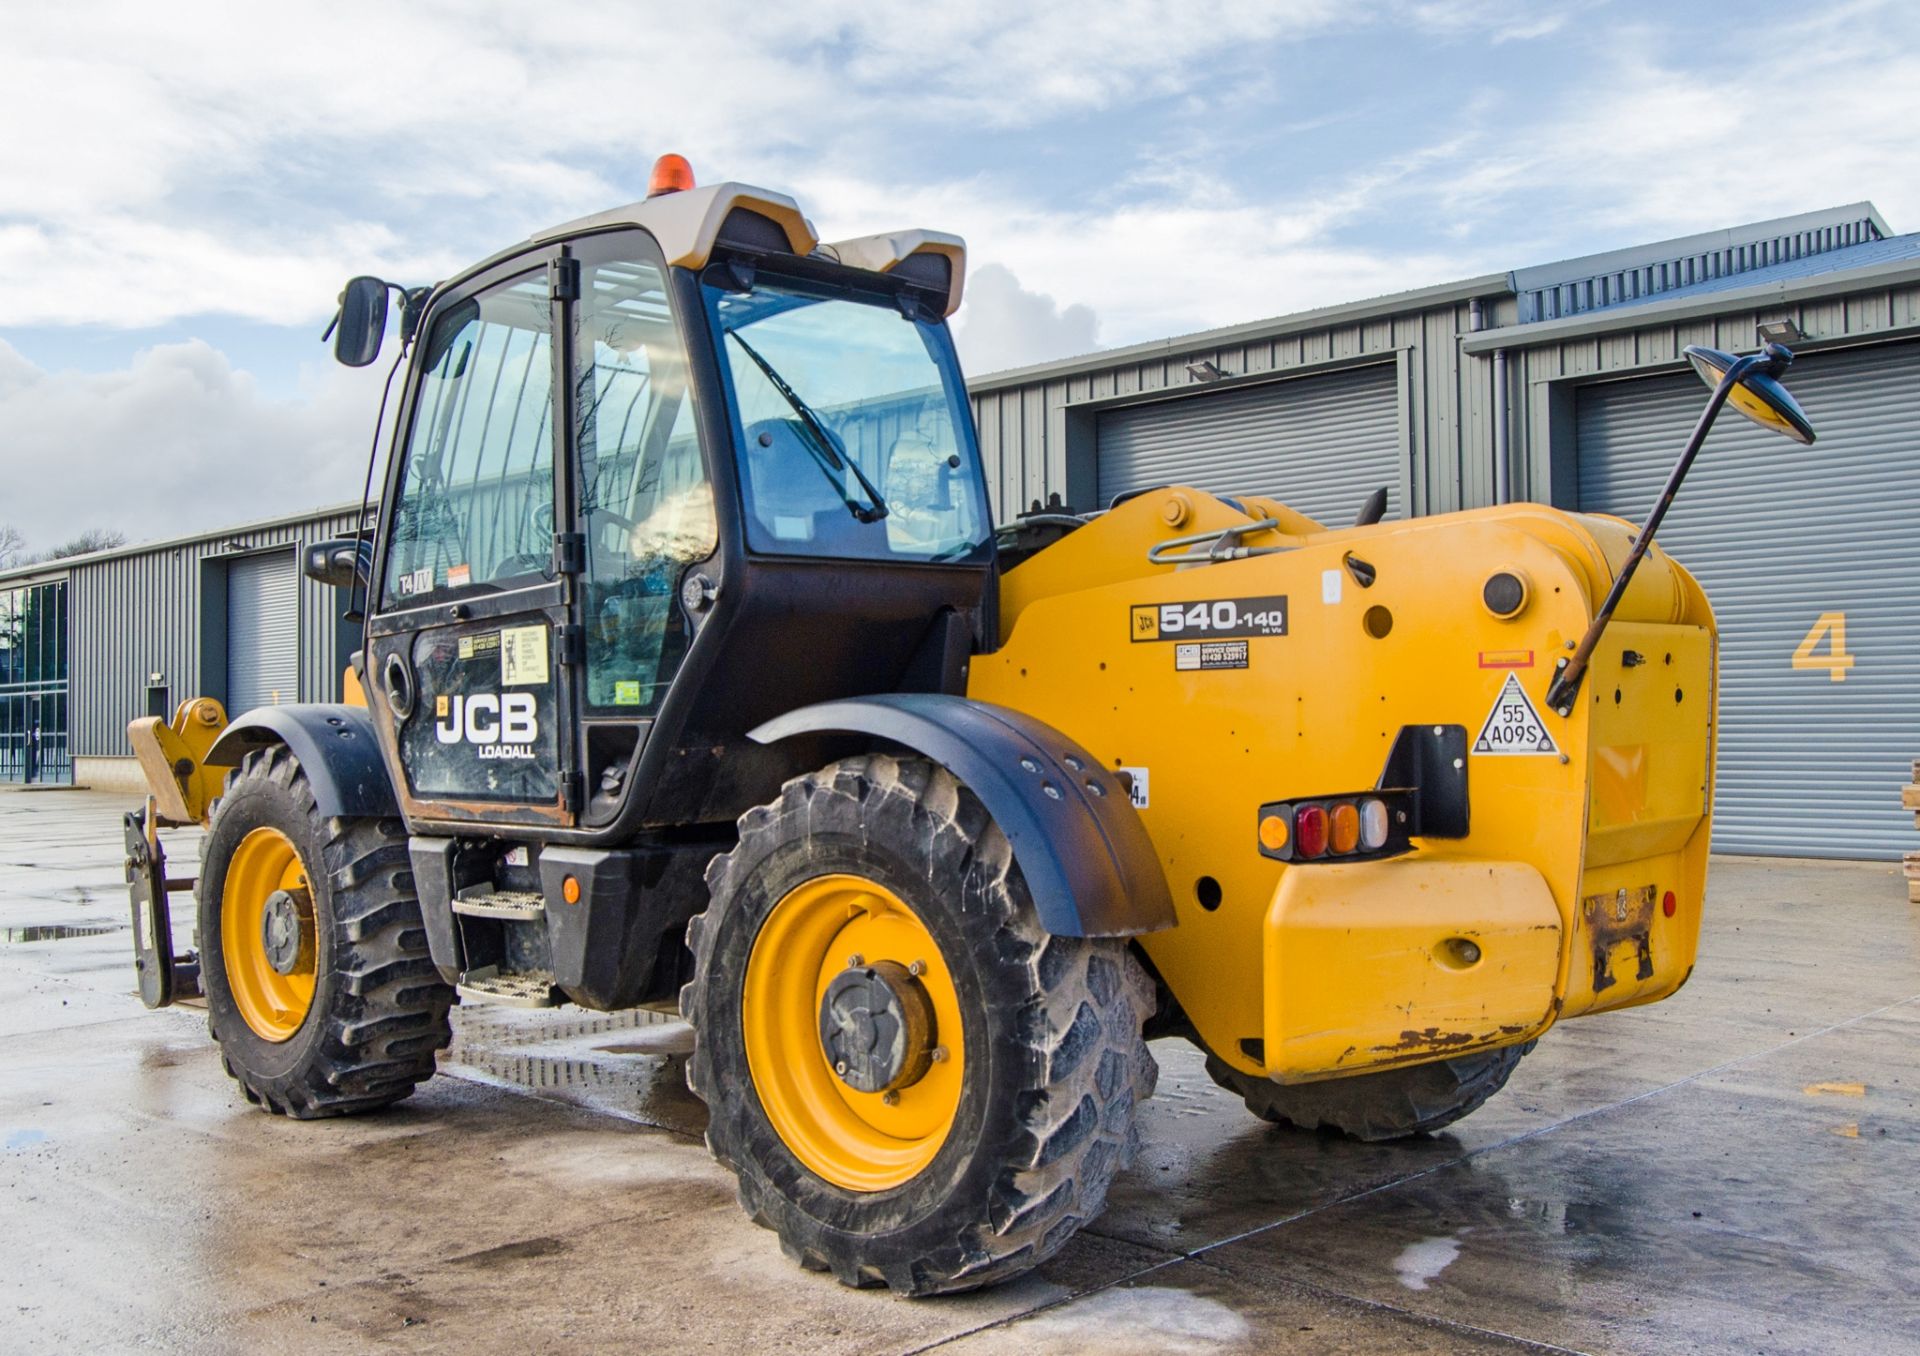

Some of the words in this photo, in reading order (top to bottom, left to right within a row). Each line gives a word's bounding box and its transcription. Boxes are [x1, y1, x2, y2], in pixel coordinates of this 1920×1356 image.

[400, 574, 413, 594] T4
[417, 570, 430, 591] IV
[1791, 612, 1855, 682] 4
[437, 693, 538, 744] JCB
[1503, 705, 1524, 723] 55
[478, 745, 536, 759] LOADALL
